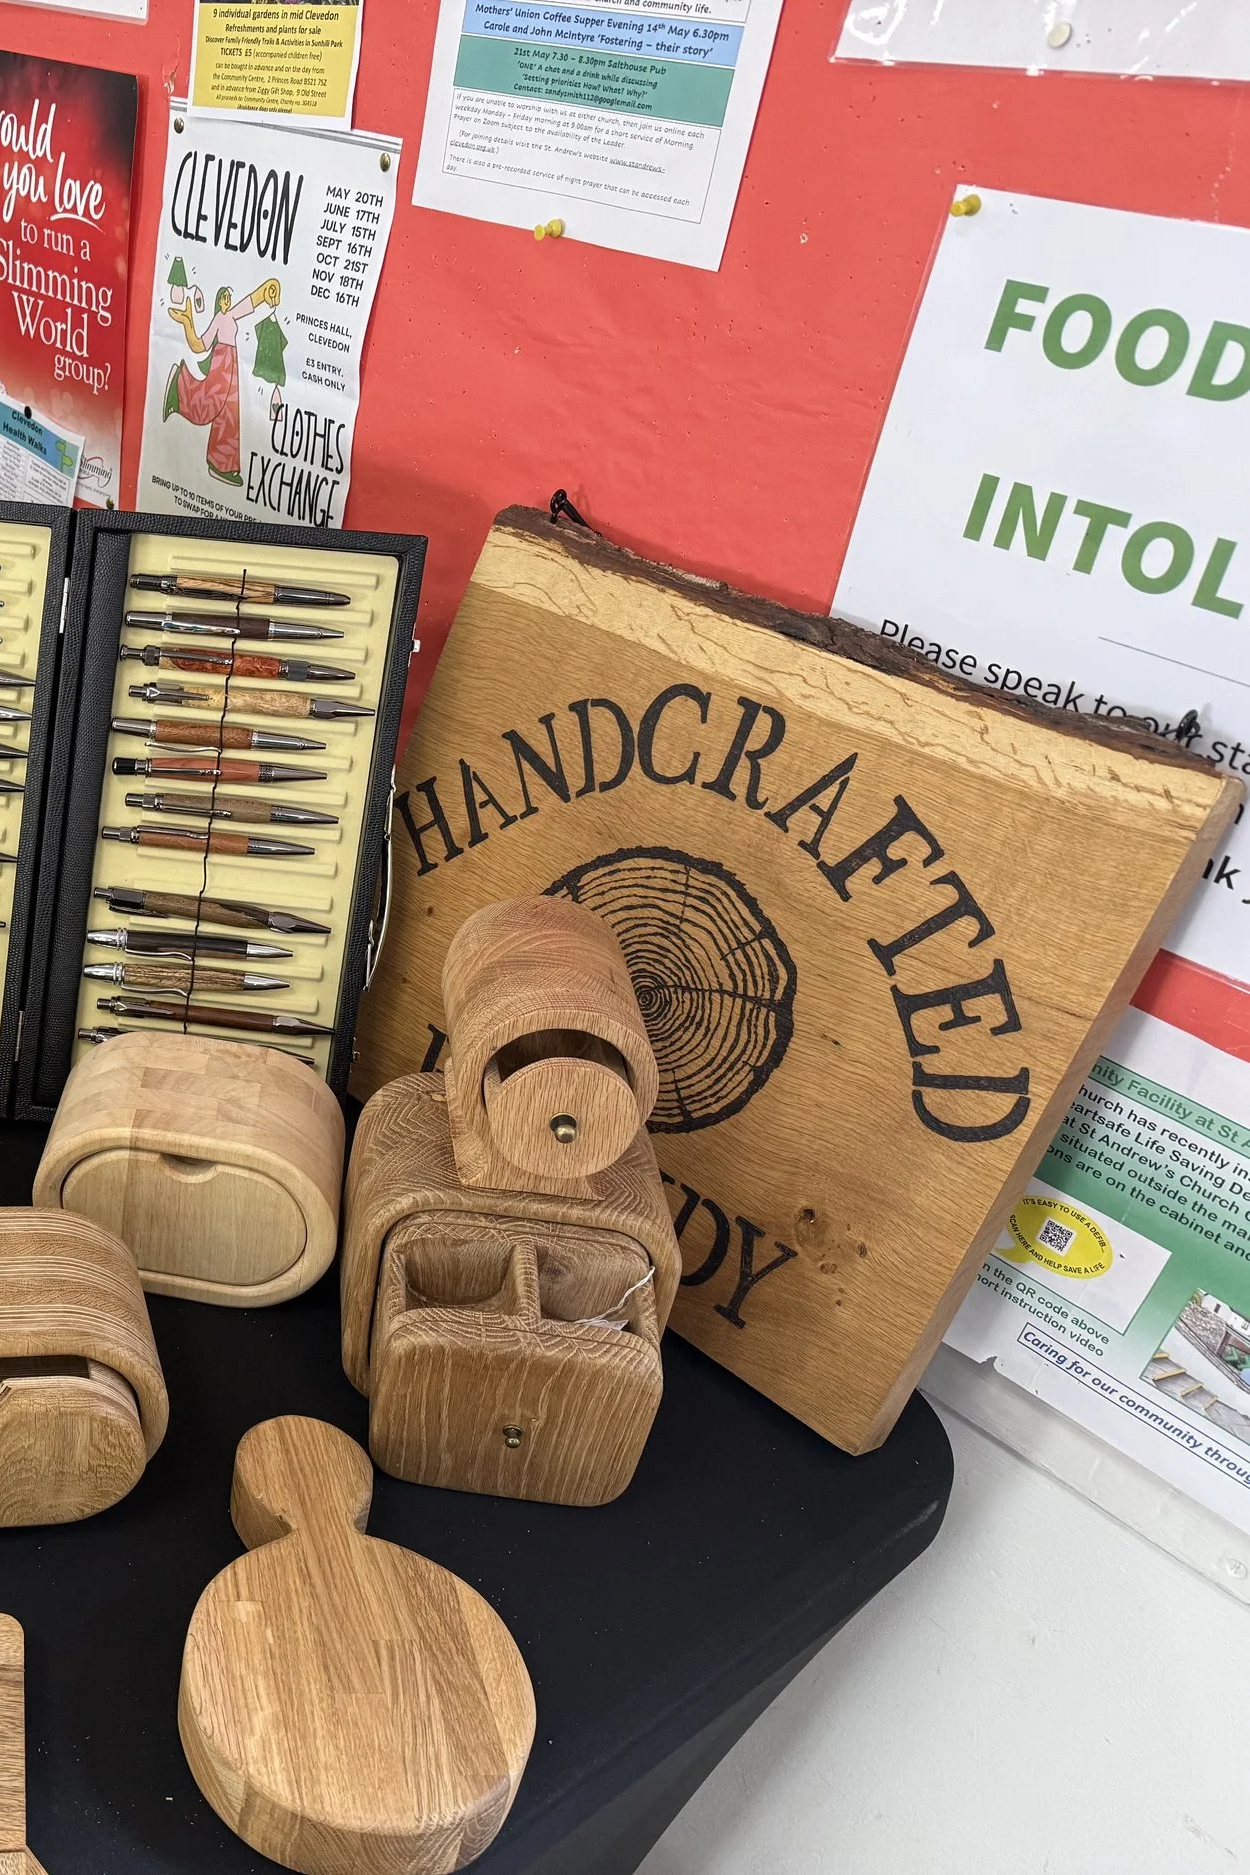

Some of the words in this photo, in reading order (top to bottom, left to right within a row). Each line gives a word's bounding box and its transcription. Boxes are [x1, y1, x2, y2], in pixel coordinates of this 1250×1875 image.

[213, 9, 217, 17] 9
[219, 8, 251, 19] individual
[252, 10, 279, 20] gardens
[281, 10, 288, 19] in
[290, 10, 303, 20] mid
[305, 10, 339, 20] Clevedon
[475, 4, 513, 16] Mothers'
[515, 9, 540, 19] Union
[543, 12, 571, 23] Coffee
[574, 15, 605, 27] Supper
[607, 19, 644, 33] Evening
[647, 23, 665, 32] 14th
[668, 26, 690, 38] May
[693, 28, 729, 42] 6.30pm
[643, 2, 691, 12] community
[695, 4, 711, 13] life.
[225, 24, 264, 33] Refreshments
[266, 25, 277, 33] and
[278, 26, 297, 35] plants
[298, 25, 307, 34] for
[309, 26, 321, 35] sale
[484, 21, 510, 32] Carole
[513, 25, 529, 34] and
[530, 27, 552, 37] John
[555, 29, 595, 43] McIntyre
[656, 41, 680, 53] their
[514, 48, 530, 56] 21st
[532, 50, 550, 60] May
[553, 52, 568, 61] 7.30
[578, 55, 605, 67] 8.30pm
[608, 60, 647, 72] Salthouse
[650, 65, 666, 75] Pub
[2, 161, 48, 223] you
[54, 152, 106, 220] love
[171, 150, 304, 265] CLEVEDON
[326, 185, 351, 200] MAY
[355, 191, 384, 208] 20TH
[320, 219, 347, 234] JULY
[351, 225, 377, 242] 15TH
[323, 203, 351, 218] JUNE
[355, 208, 381, 225] 17TH
[21, 219, 38, 244] to
[43, 227, 75, 256] run
[80, 240, 91, 261] a
[316, 235, 343, 251] SEPT
[347, 242, 373, 258] 16TH
[312, 269, 336, 284] NOV
[339, 275, 364, 291] 18TH
[316, 253, 340, 268] OCT
[343, 259, 369, 275] 21ST
[310, 285, 331, 300] DEC
[335, 292, 360, 308] 16TH
[12, 291, 89, 358] World
[295, 313, 329, 331] PRINCES
[330, 323, 352, 339] HALL,
[308, 333, 350, 354] CLEVEDON
[984, 278, 1250, 402] FOOD
[54, 354, 111, 395] group?
[302, 371, 323, 386] CASH
[324, 377, 346, 392] ONLY
[305, 358, 316, 368] £3
[316, 360, 344, 378] ENTRY.
[3, 421, 27, 445] Health
[28, 434, 47, 456] Walks
[11, 410, 43, 435] Clevedon
[271, 403, 346, 475] CLOTHES
[152, 475, 171, 489] BRING
[172, 483, 180, 493] UP
[180, 487, 189, 496] TO
[189, 492, 196, 500] 10
[196, 495, 214, 509] ITEMS
[215, 502, 224, 512] OF
[224, 506, 246, 520] YOUR
[246, 452, 340, 528] EXCHANGE
[962, 472, 1245, 621] INTOL
[984, 659, 1085, 716] speak
[394, 681, 1032, 1143] HANDCRAFTED
[1078, 1083, 1124, 1115] hurch
[1127, 1110, 1157, 1132] has
[1161, 1128, 1230, 1169] recently
[1127, 1079, 1193, 1119] Facility
[1195, 1114, 1215, 1131] at
[1218, 1125, 1239, 1143] St
[1060, 1132, 1125, 1172] situated
[1127, 1168, 1188, 1205] outside
[1191, 1200, 1218, 1222] the
[1062, 1115, 1076, 1129] at
[1079, 1122, 1096, 1139] St
[1098, 1134, 1175, 1179] Andrew's
[1180, 1175, 1240, 1214] Church
[1135, 1132, 1166, 1155] Life
[1169, 1150, 1226, 1188] Saving
[1038, 1199, 1058, 1209] EASY
[1060, 1204, 1069, 1213] TO
[1070, 1210, 1087, 1223] USE
[1085, 1221, 1091, 1229] A
[1076, 1160, 1102, 1179] are
[1106, 1178, 1126, 1192] on
[1130, 1186, 1156, 1207] the
[1159, 1205, 1222, 1244] cabinet
[1016, 1232, 1031, 1250] HERE
[1029, 1248, 1043, 1261] AND
[1044, 1258, 1062, 1269] HELP
[1063, 1265, 1082, 1274] SAVE
[1090, 1262, 1105, 1274] LIFE
[993, 1267, 1013, 1285] the
[1016, 1282, 1036, 1298] QR
[1038, 1296, 1068, 1319] code
[1071, 1316, 1110, 1345] above
[1001, 1288, 1066, 1334] instruction
[1069, 1331, 1104, 1357] video
[1024, 1331, 1068, 1366] Caring
[1066, 1361, 1092, 1379] for
[1092, 1378, 1119, 1396] our
[1119, 1394, 1203, 1449] community
